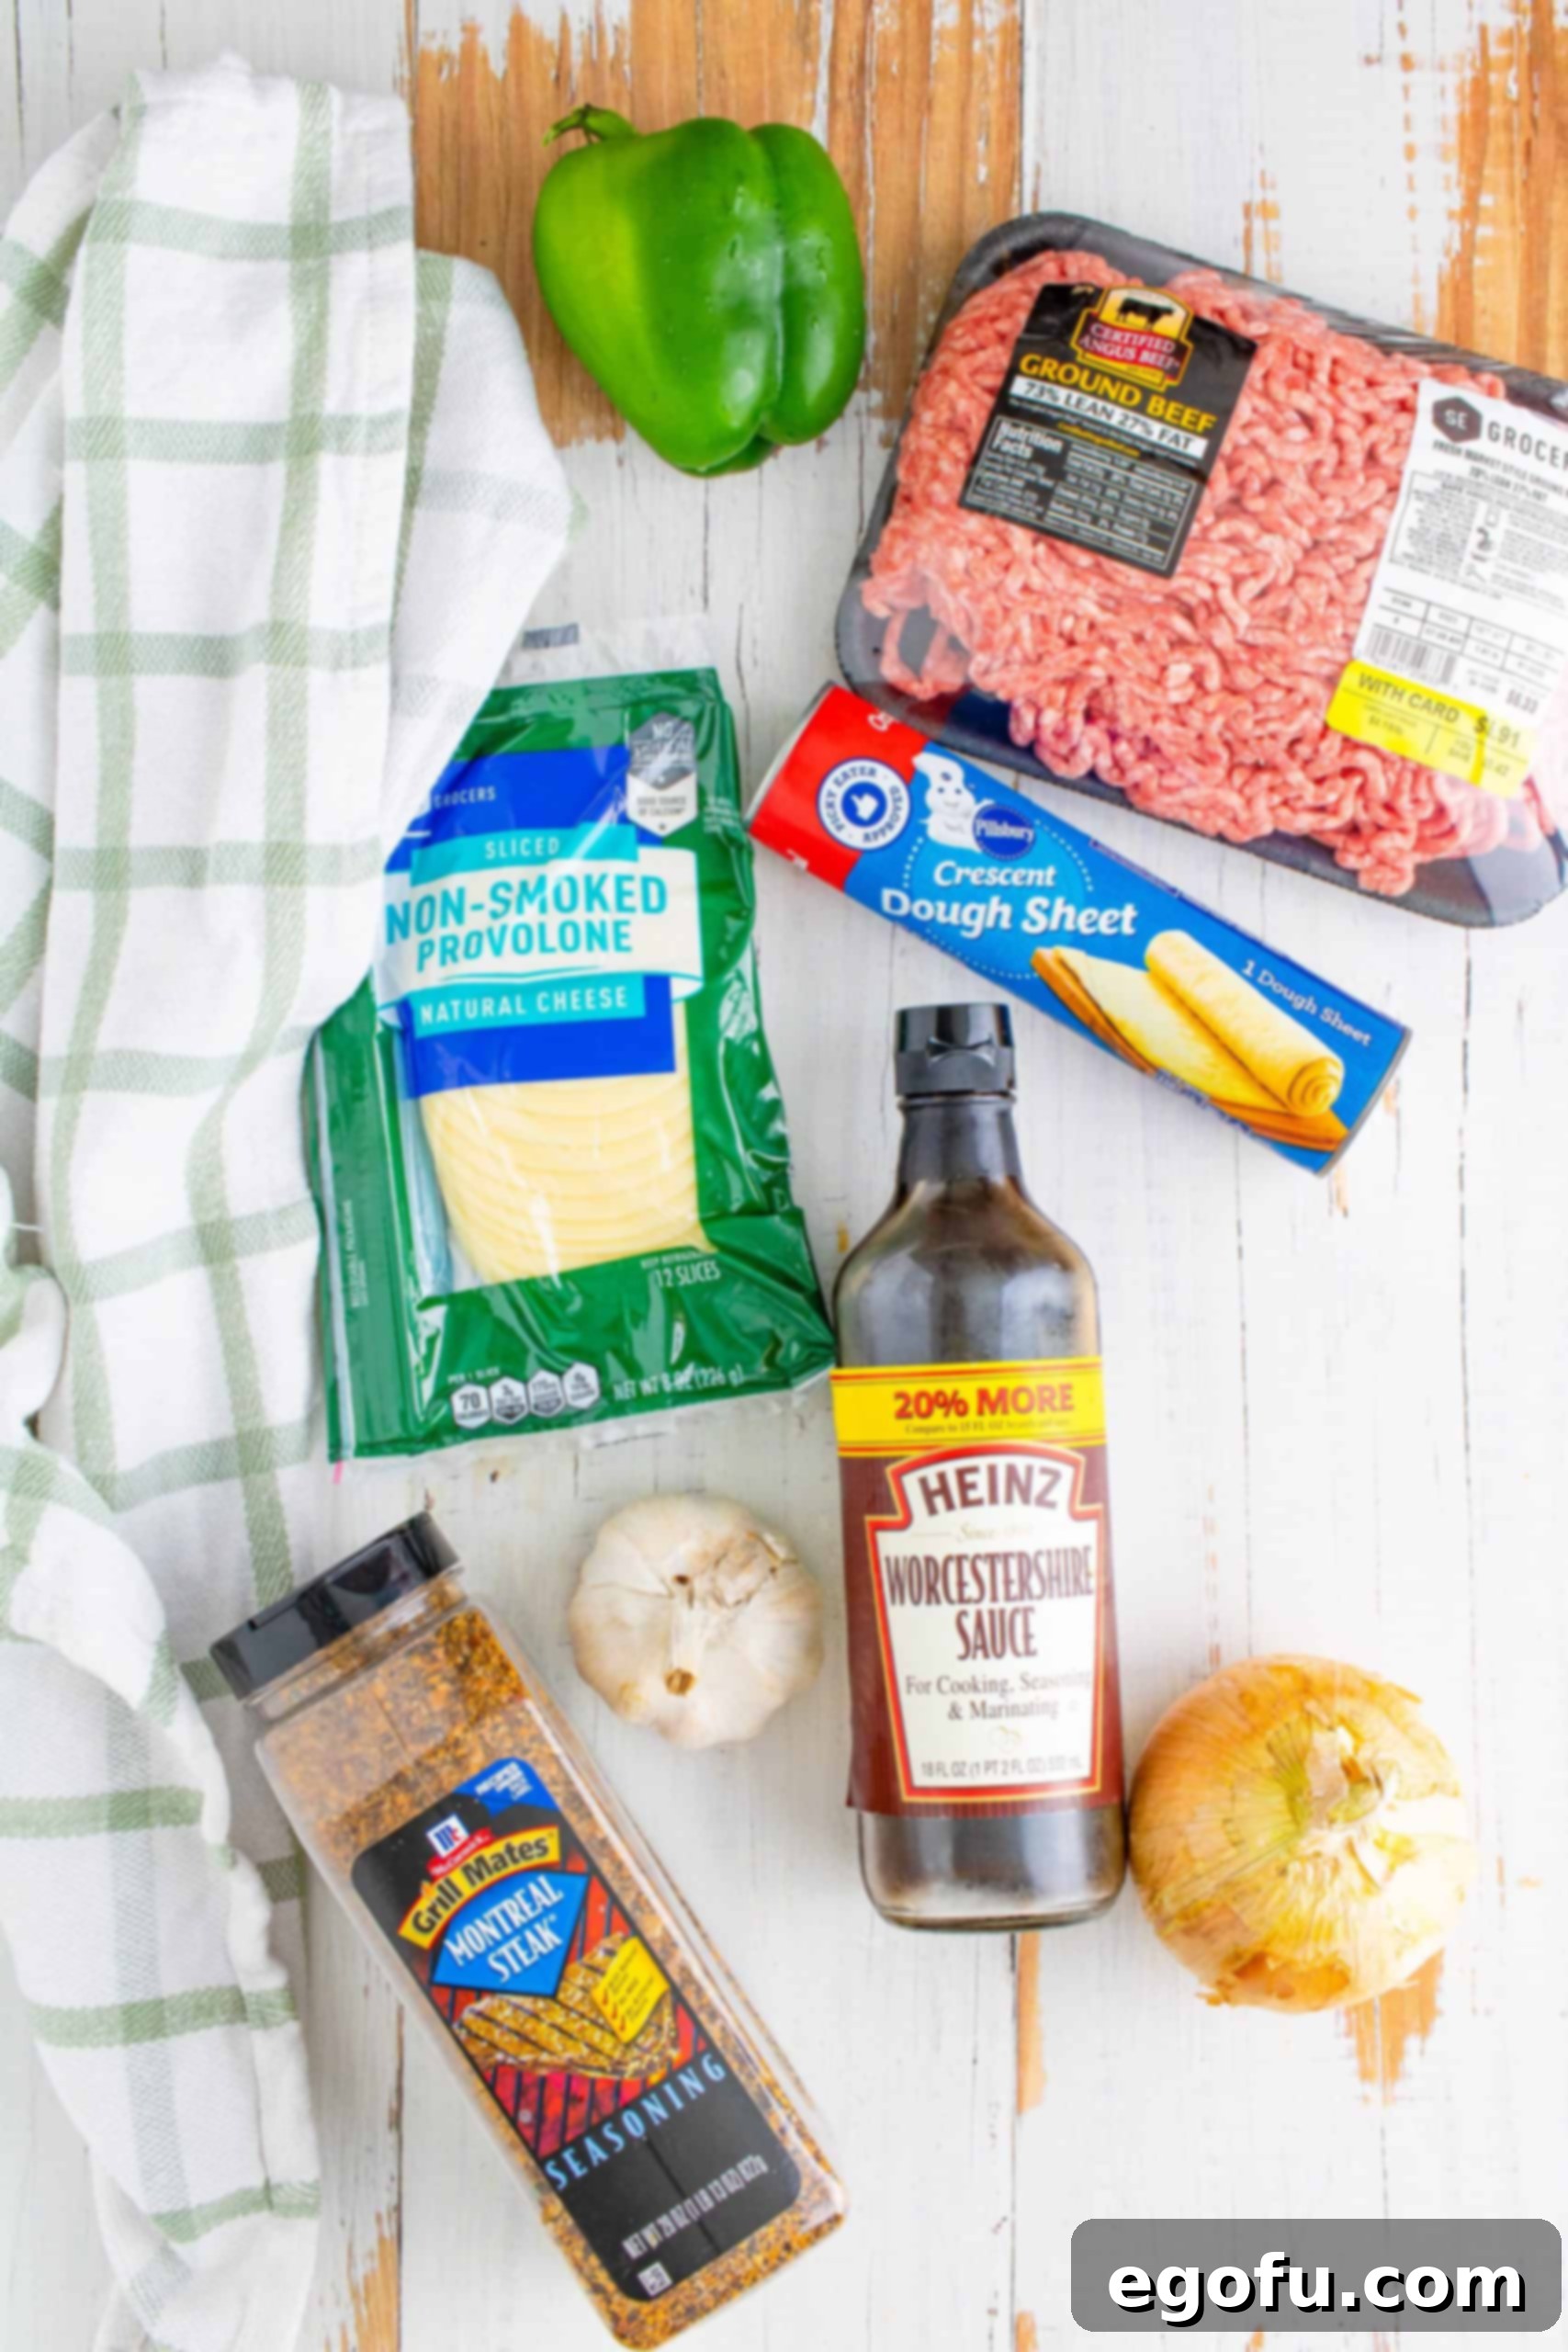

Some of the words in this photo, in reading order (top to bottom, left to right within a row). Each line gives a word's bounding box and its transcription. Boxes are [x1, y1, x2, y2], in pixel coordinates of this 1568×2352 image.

[1079, 336, 1137, 363] ANGUS
[1089, 322, 1176, 355] CERTIFIED
[1020, 354, 1142, 407] GROUND
[1147, 394, 1217, 434] BEEF
[1024, 381, 1060, 404] 73%
[1065, 392, 1115, 422] LEAN
[1118, 411, 1154, 437] 27%
[1157, 425, 1192, 451] FAT
[1444, 408, 1469, 430] SE
[991, 439, 1033, 459] Facts
[998, 423, 1063, 454] Nutrition
[1358, 672, 1406, 704] WITH
[1407, 692, 1461, 724] CARD
[833, 764, 877, 786] EATER
[825, 788, 845, 832] PICKY
[862, 785, 903, 842] APPROVED
[484, 836, 561, 860] SLICED
[974, 818, 1034, 845] Pillsbury
[932, 860, 1056, 888] Crescent
[384, 873, 668, 947] NON-SMOKED
[880, 888, 1012, 940] Dough
[1021, 896, 1138, 936] Sheet
[416, 920, 634, 974] PROVOLONE
[421, 990, 527, 1026] NATURAL
[536, 985, 628, 1014] CHEESE
[1241, 960, 1256, 978] 1
[1257, 969, 1317, 1015] Dough
[1320, 1006, 1372, 1047] Sheet
[653, 1267, 673, 1288] 12
[674, 1260, 721, 1286] SLICES
[457, 1392, 483, 1410] 70
[613, 1383, 637, 1402] NET
[893, 1389, 969, 1419] 20%
[976, 1384, 1075, 1417] MORE
[917, 1463, 1063, 1518] HEINZ
[885, 1545, 1094, 1607] WORCESTERSHIRE
[954, 1606, 1038, 1661] SAUCE
[905, 1674, 932, 1695] For
[935, 1670, 1015, 1699] Cooking,
[947, 1702, 964, 1721] &
[969, 1697, 1060, 1721] Marinating
[920, 1760, 935, 1778] 18
[935, 1760, 951, 1779] FL
[952, 1760, 968, 1778] OZ
[983, 1758, 1000, 1777] PT
[412, 1877, 465, 1936] Grill
[460, 1836, 550, 1890] Mates
[443, 1873, 564, 1968] MONTREAL
[487, 1917, 563, 1984] STEAK
[545, 2052, 726, 2190] SEASONING
[622, 2233, 646, 2259] NET
